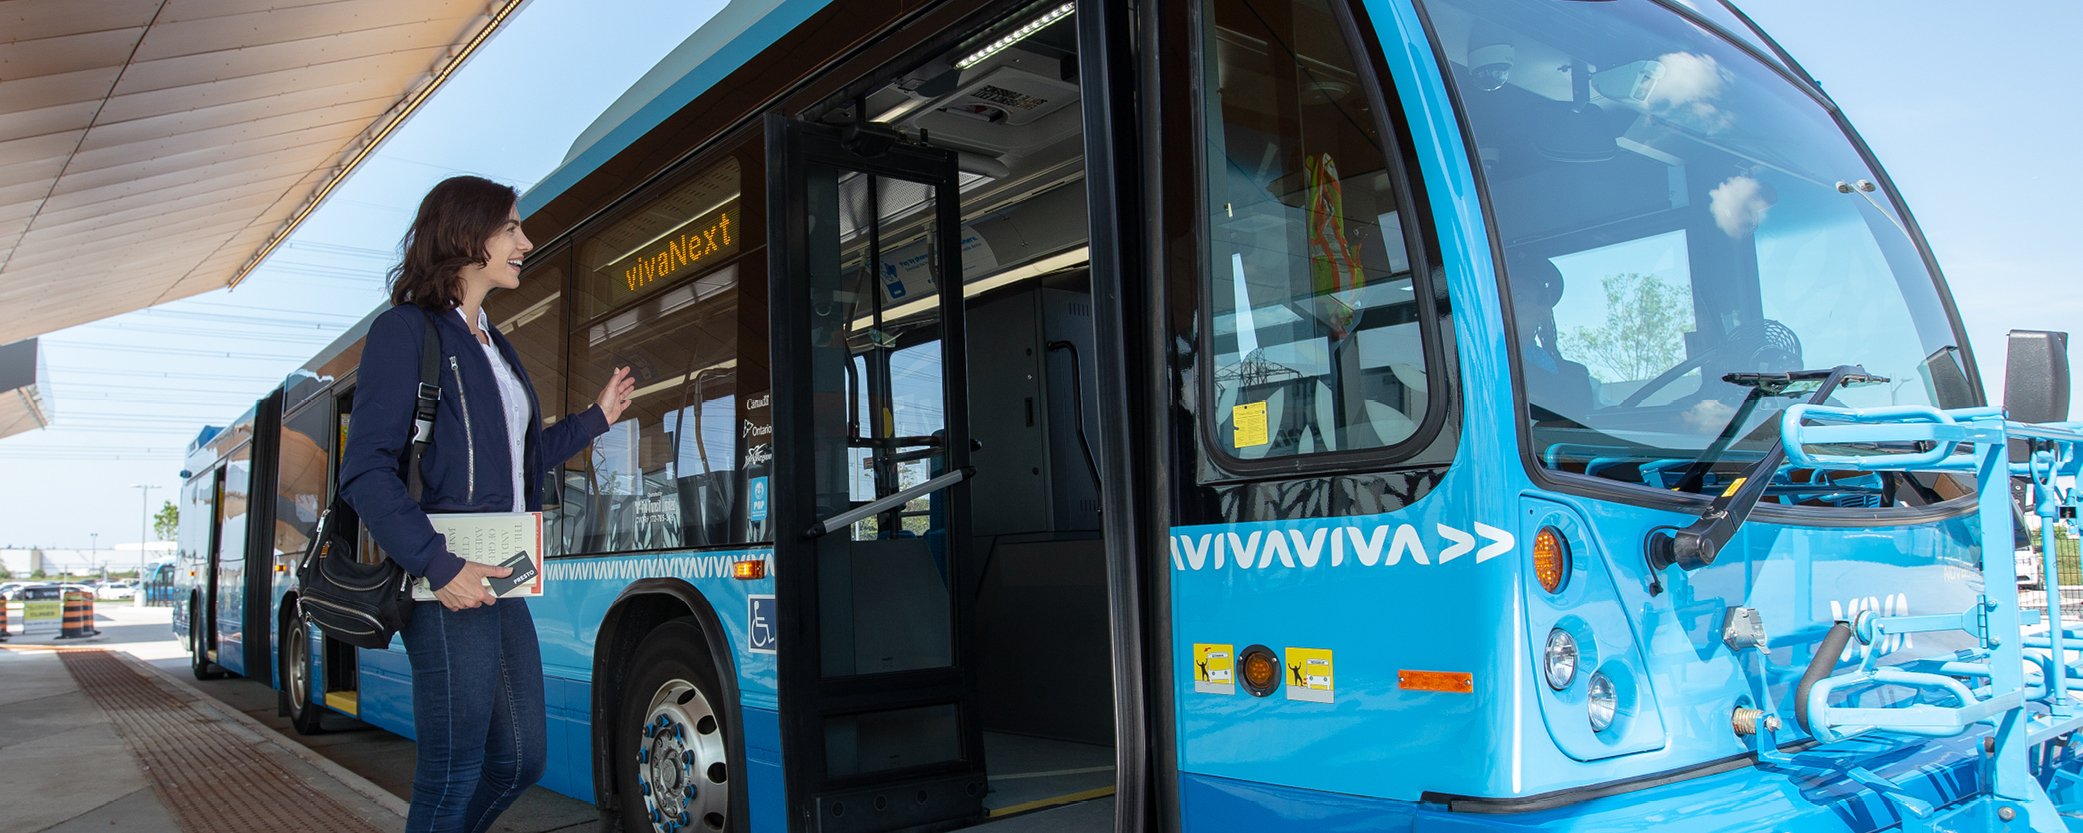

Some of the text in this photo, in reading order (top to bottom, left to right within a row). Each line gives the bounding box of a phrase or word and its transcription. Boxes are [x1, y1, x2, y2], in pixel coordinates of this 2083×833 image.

[626, 213, 731, 291] vivaNext
[752, 424, 773, 436] Ontario
[501, 530, 509, 550] AND
[514, 521, 523, 543] THE
[487, 528, 497, 562] OF GRE
[513, 569, 535, 584] PRESTO
